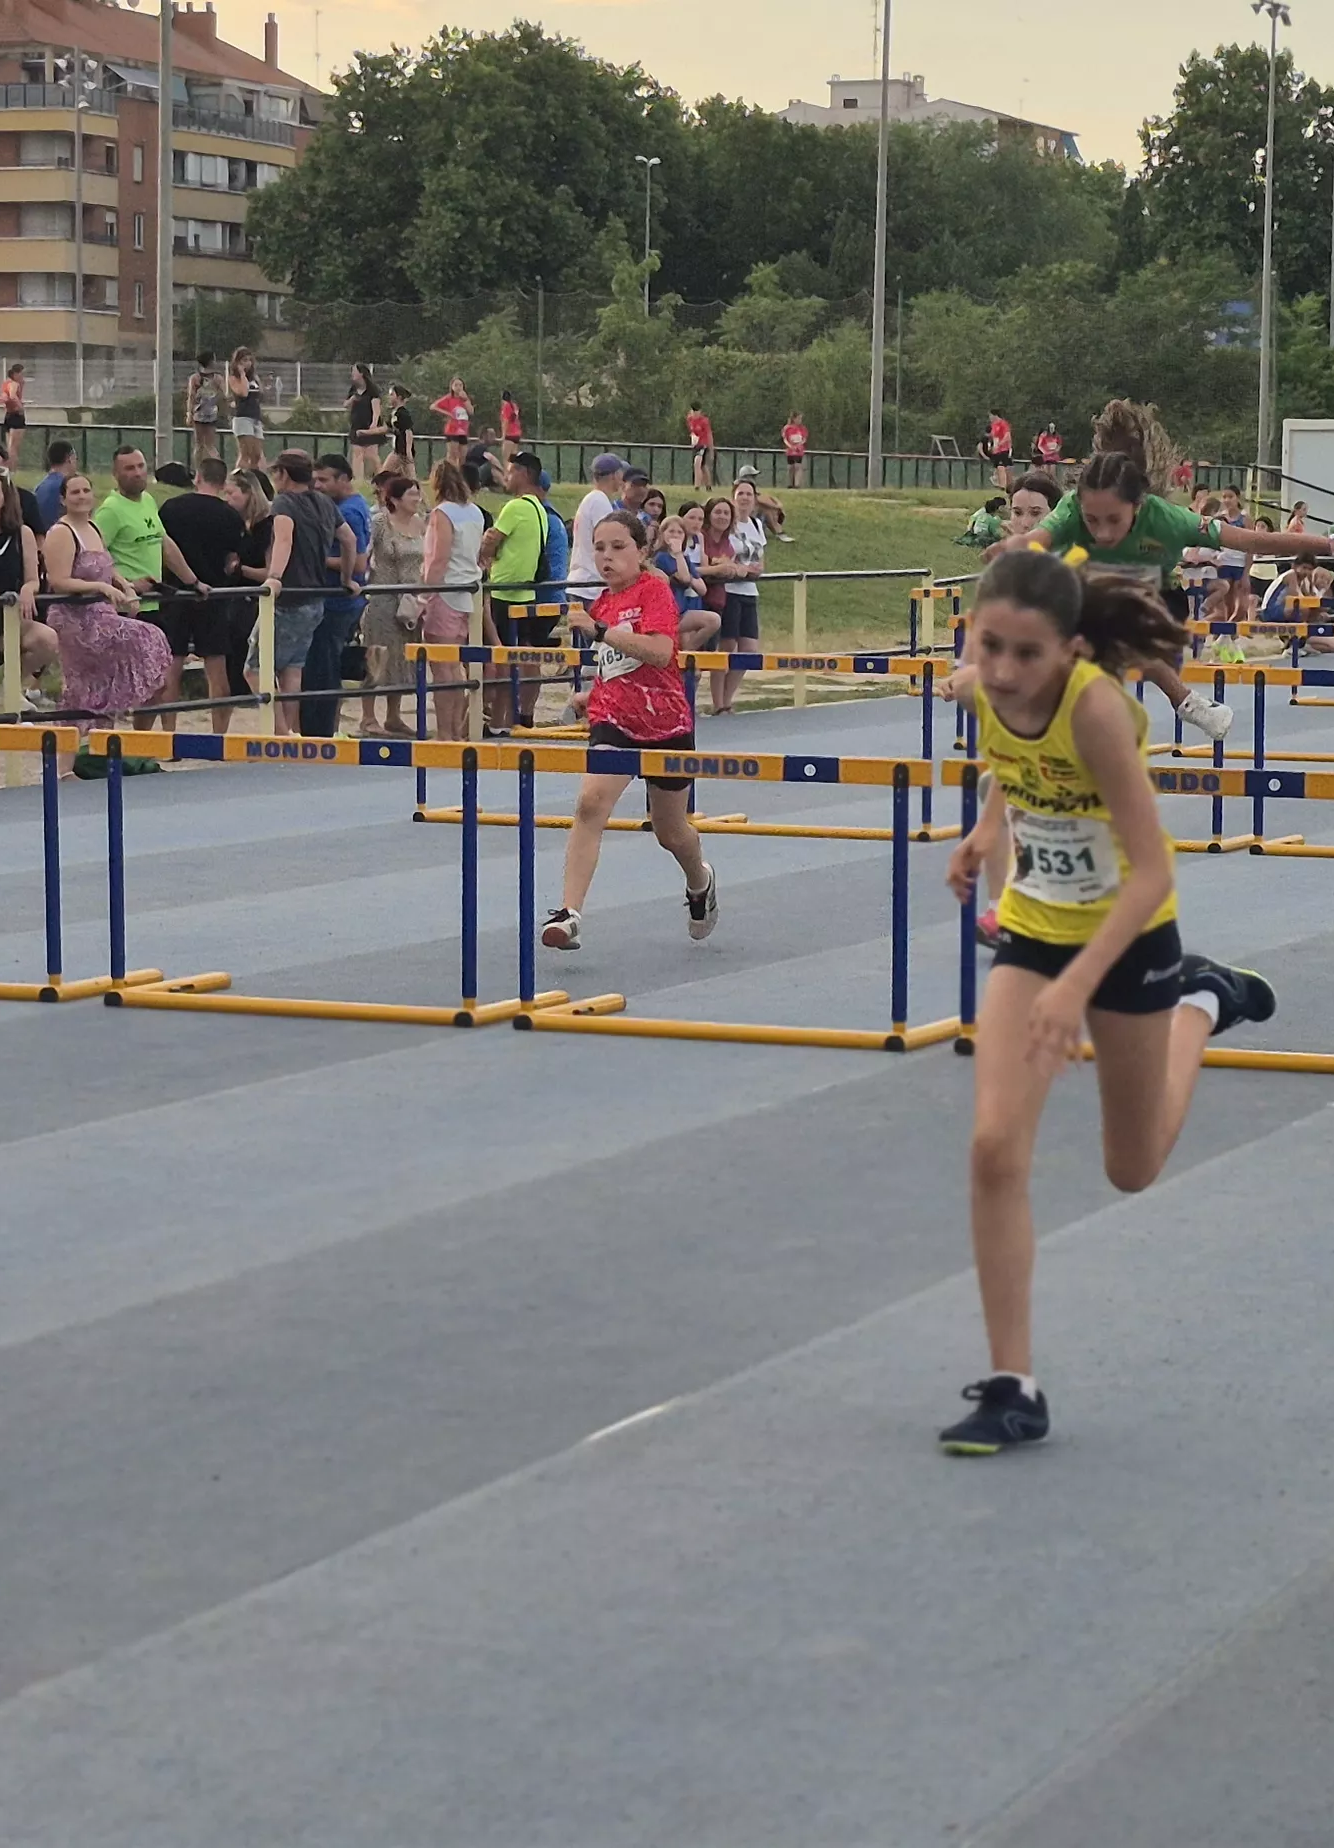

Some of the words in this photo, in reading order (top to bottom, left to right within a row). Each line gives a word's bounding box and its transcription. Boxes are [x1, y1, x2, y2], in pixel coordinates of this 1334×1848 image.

[507, 650, 566, 664] MONDO
[778, 657, 838, 670] MONDO
[247, 739, 337, 760] MONDO
[664, 756, 760, 777] MONDO
